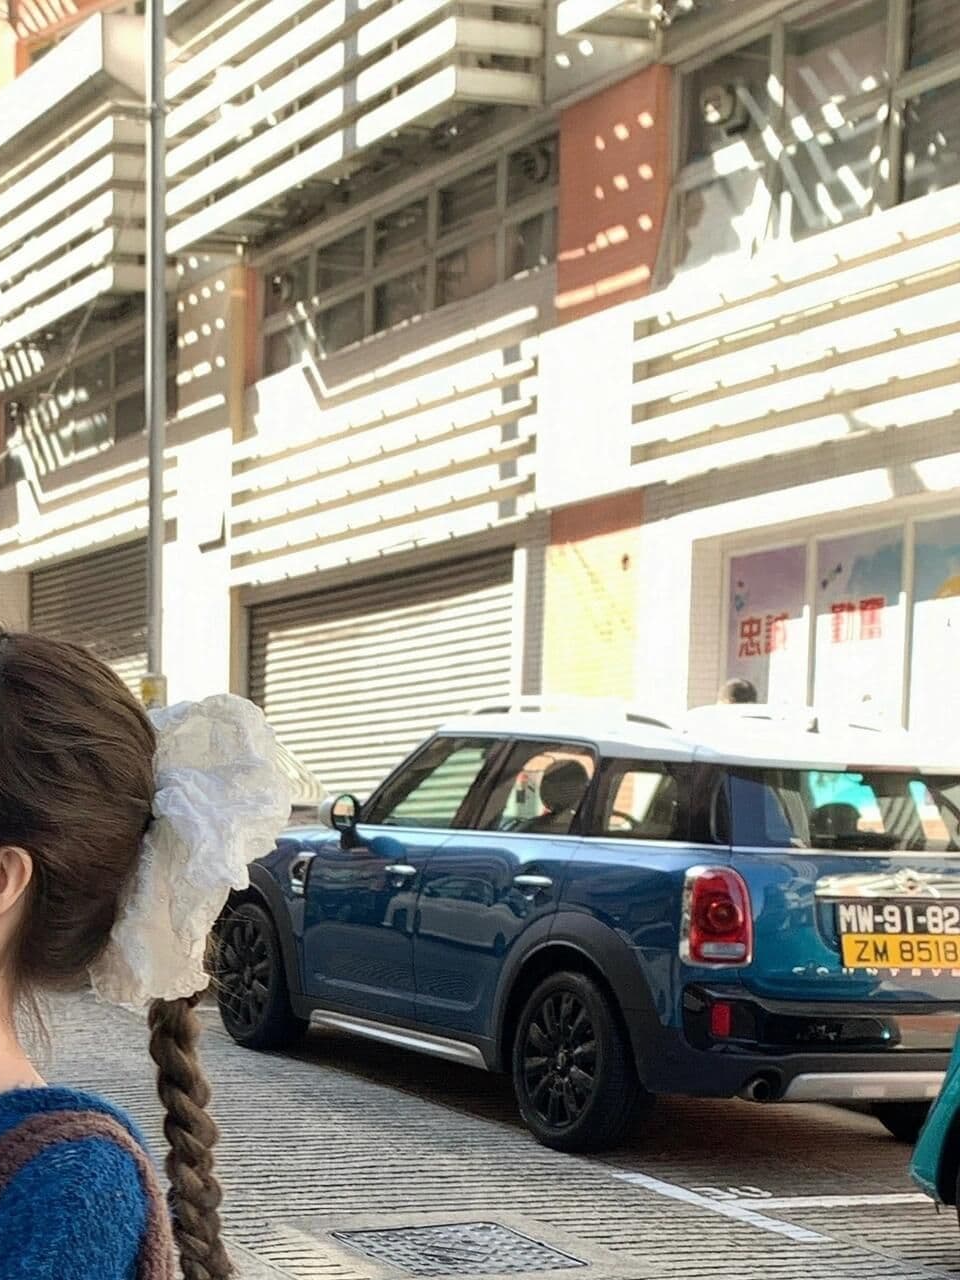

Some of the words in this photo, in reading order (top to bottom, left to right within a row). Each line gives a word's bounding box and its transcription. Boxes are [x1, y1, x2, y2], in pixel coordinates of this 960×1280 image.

[839, 904, 960, 934] MW-91-82
[854, 940, 890, 963] ZM
[899, 940, 959, 963] 8518
